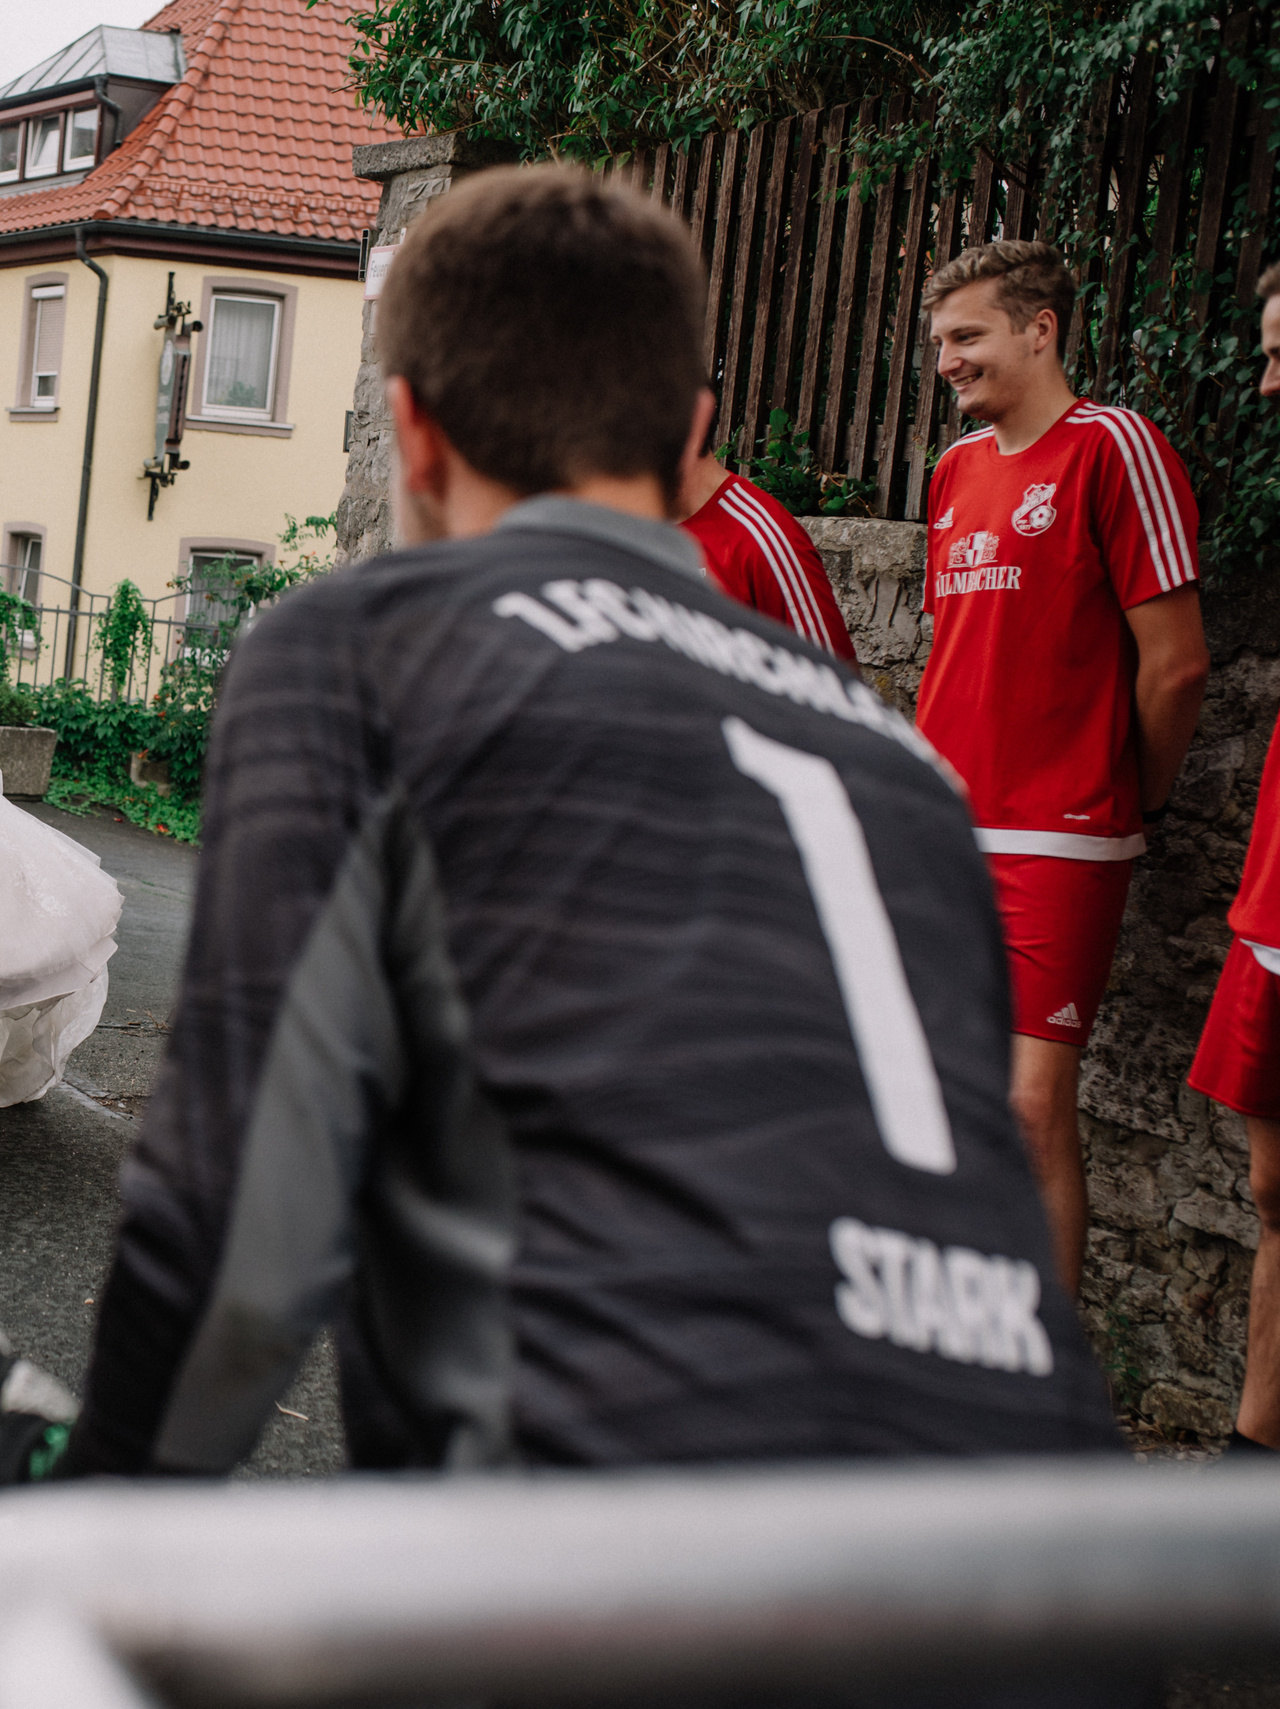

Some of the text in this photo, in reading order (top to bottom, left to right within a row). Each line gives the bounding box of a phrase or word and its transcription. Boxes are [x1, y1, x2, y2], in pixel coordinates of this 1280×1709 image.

[370, 260, 389, 279] Feuer
[722, 714, 957, 1176] 1
[828, 1215, 1055, 1378] STARK
